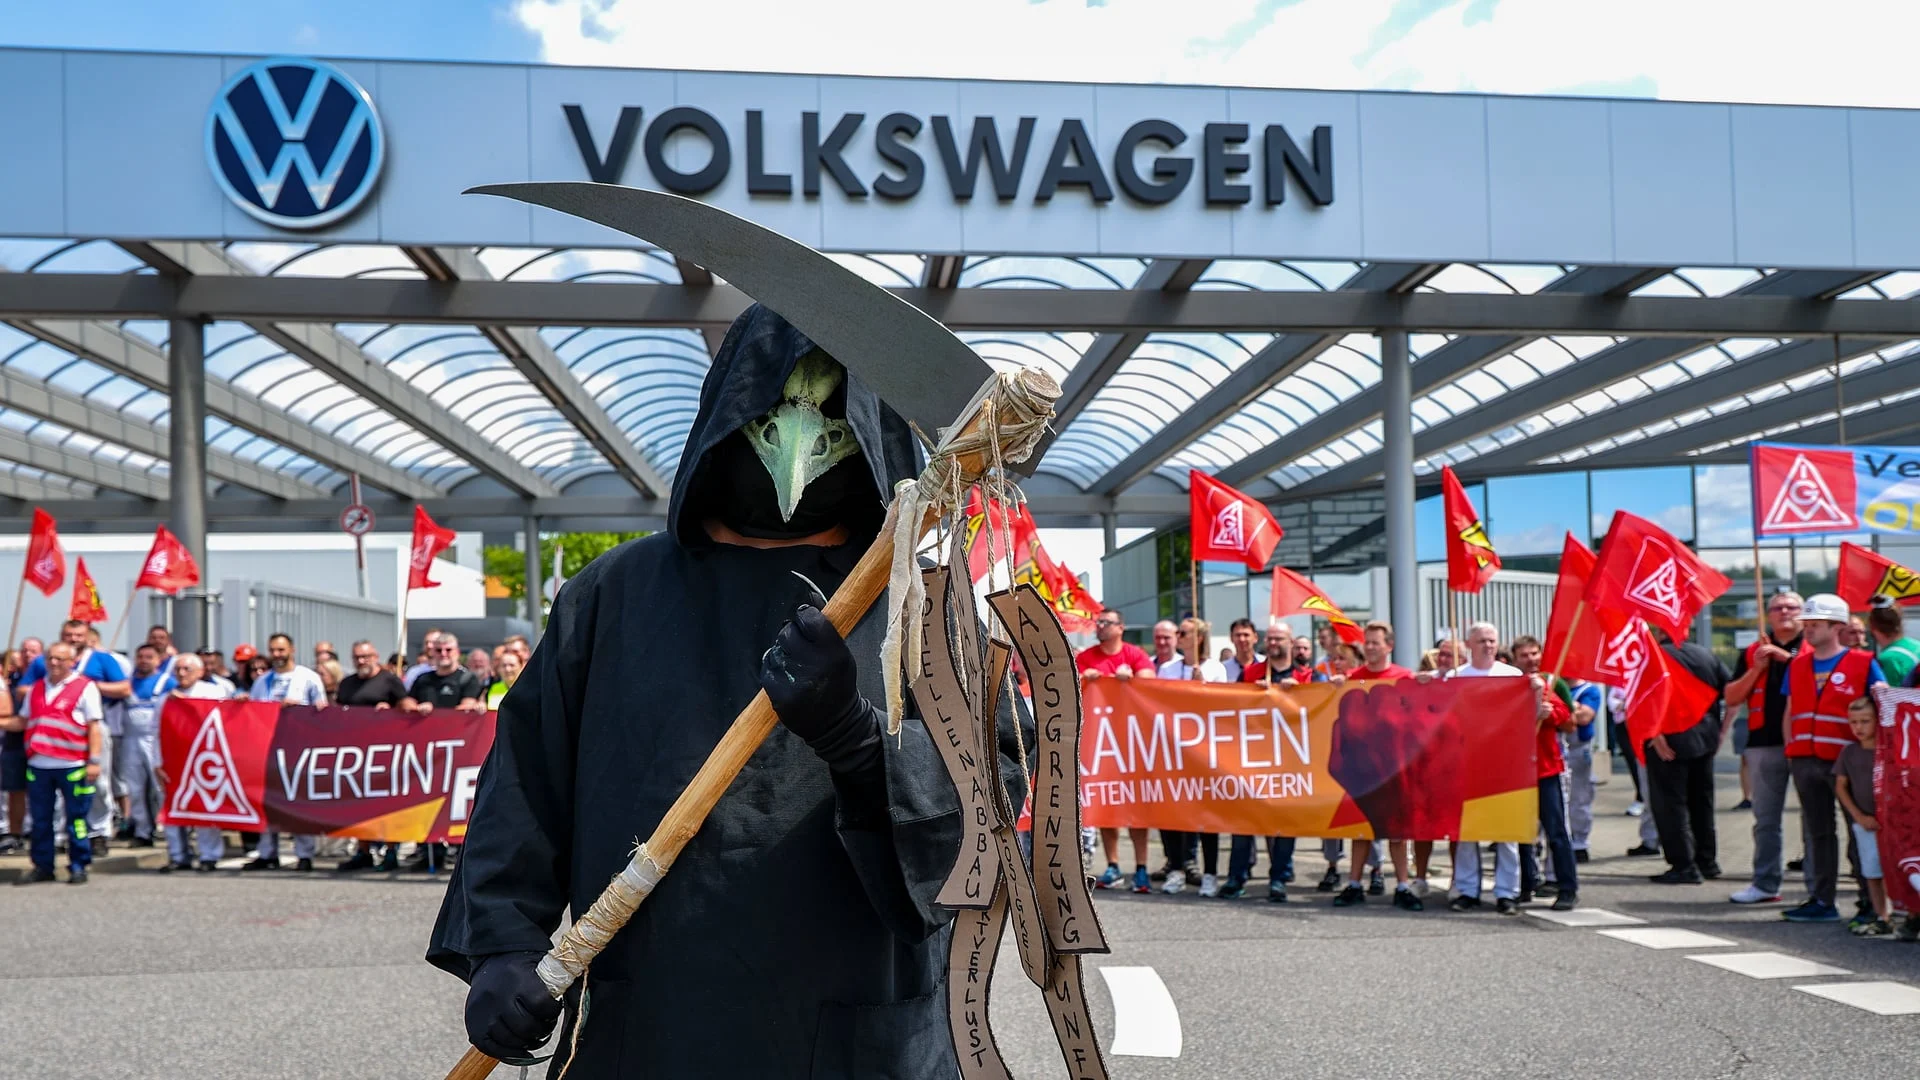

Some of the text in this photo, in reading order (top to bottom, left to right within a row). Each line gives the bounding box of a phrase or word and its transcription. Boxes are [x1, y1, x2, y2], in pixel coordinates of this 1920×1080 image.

[209, 62, 378, 220] VW
[562, 103, 1334, 207] VOLKSWAGEN
[174, 718, 253, 818] IGM
[277, 740, 465, 801] VEREINT
[1018, 605, 1081, 944] AUSGRENZUNG
[1140, 777, 1164, 803] IM
[1169, 772, 1313, 801] VW-KONZERN
